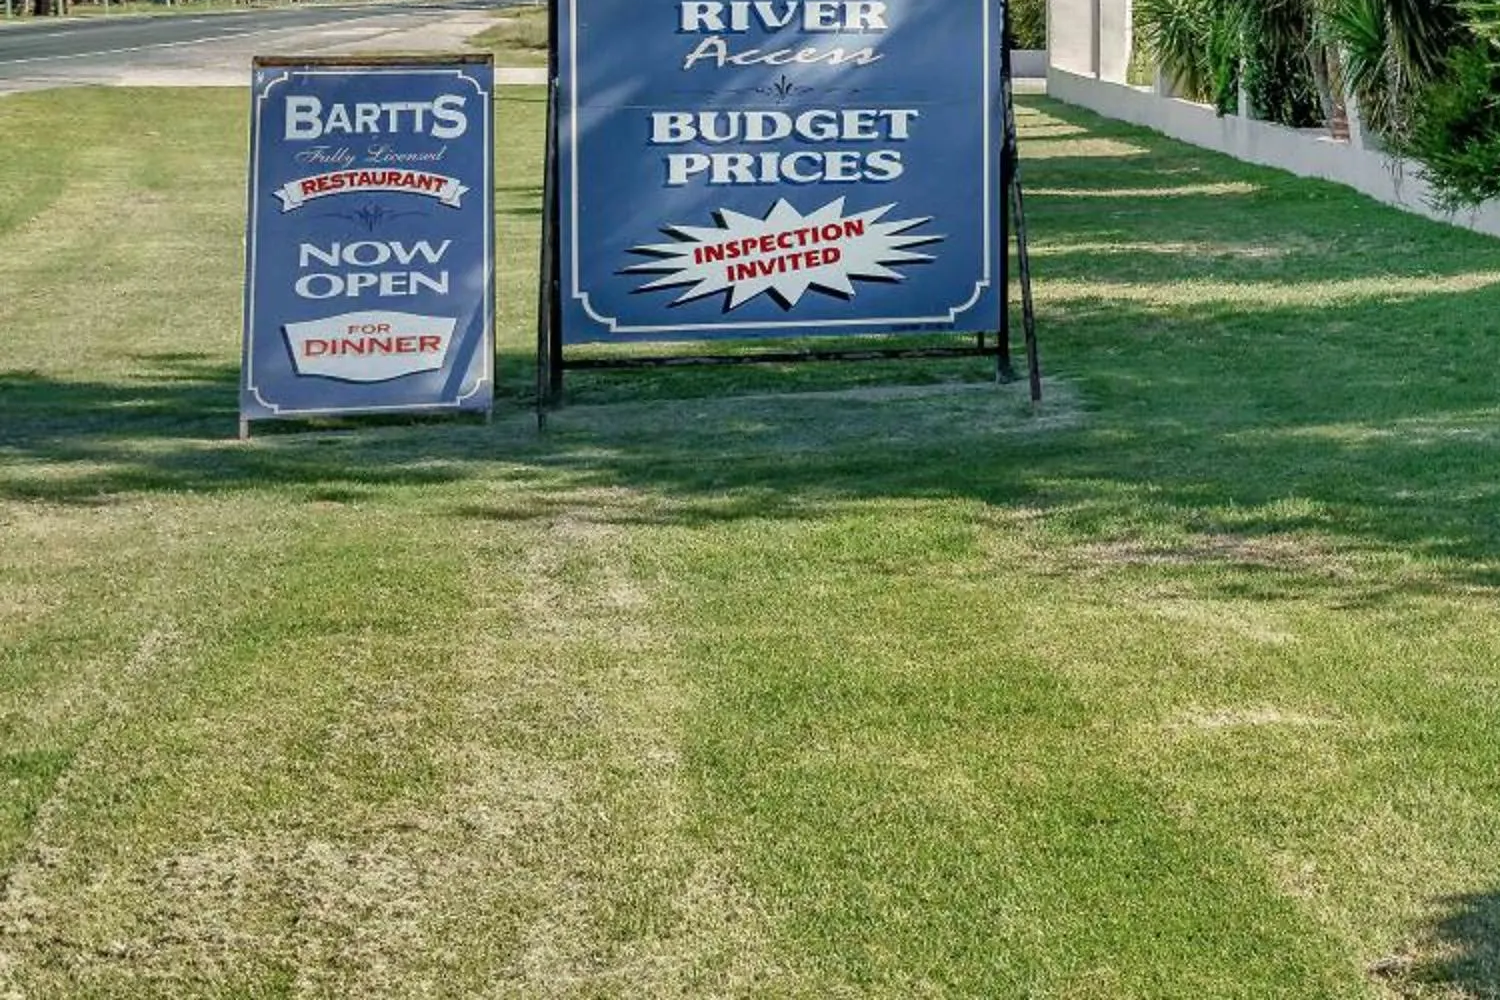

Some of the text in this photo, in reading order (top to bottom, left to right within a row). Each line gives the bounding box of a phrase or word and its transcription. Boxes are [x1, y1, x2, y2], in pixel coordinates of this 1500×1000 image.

[681, 0, 889, 31] RIVER
[684, 35, 884, 71] Access
[285, 94, 468, 141] BARTTS
[652, 109, 919, 143] BUDGET
[301, 171, 449, 195] RESTAURANT
[667, 150, 904, 185] PRICES
[300, 239, 452, 268] NOW
[694, 219, 865, 264] INSPECTION
[727, 246, 841, 282] INVITED
[295, 270, 449, 299] OPEN
[347, 323, 391, 335] FOR
[304, 335, 442, 357] DINNER
